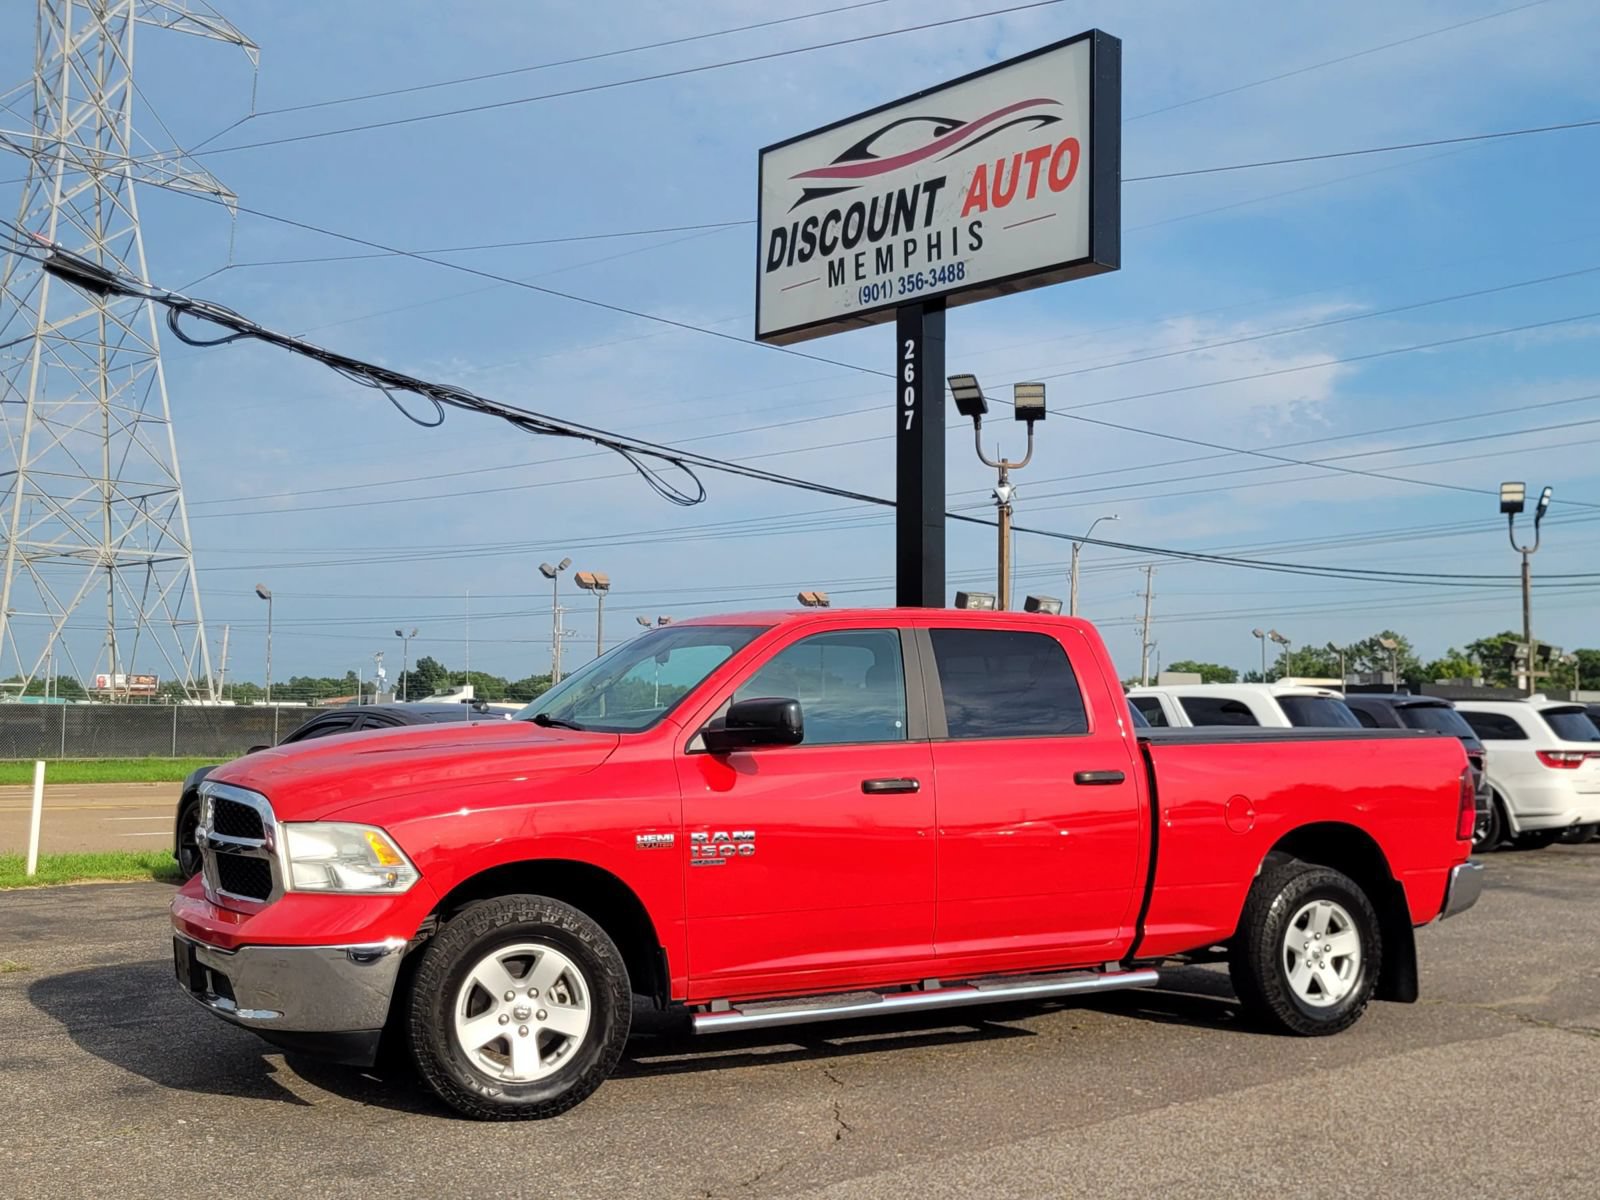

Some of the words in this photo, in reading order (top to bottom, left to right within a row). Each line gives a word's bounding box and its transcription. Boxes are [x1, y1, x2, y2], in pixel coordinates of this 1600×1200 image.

[766, 175, 947, 273] DISCOUNT
[960, 137, 1081, 218] AUTO
[828, 221, 983, 288] MEMPHIS
[858, 279, 893, 305] (901)
[898, 261, 965, 295] 356-3488
[904, 339, 915, 430] 2607
[636, 833, 674, 843] HEMI
[690, 831, 755, 844] RAM
[690, 844, 755, 857] 1500
